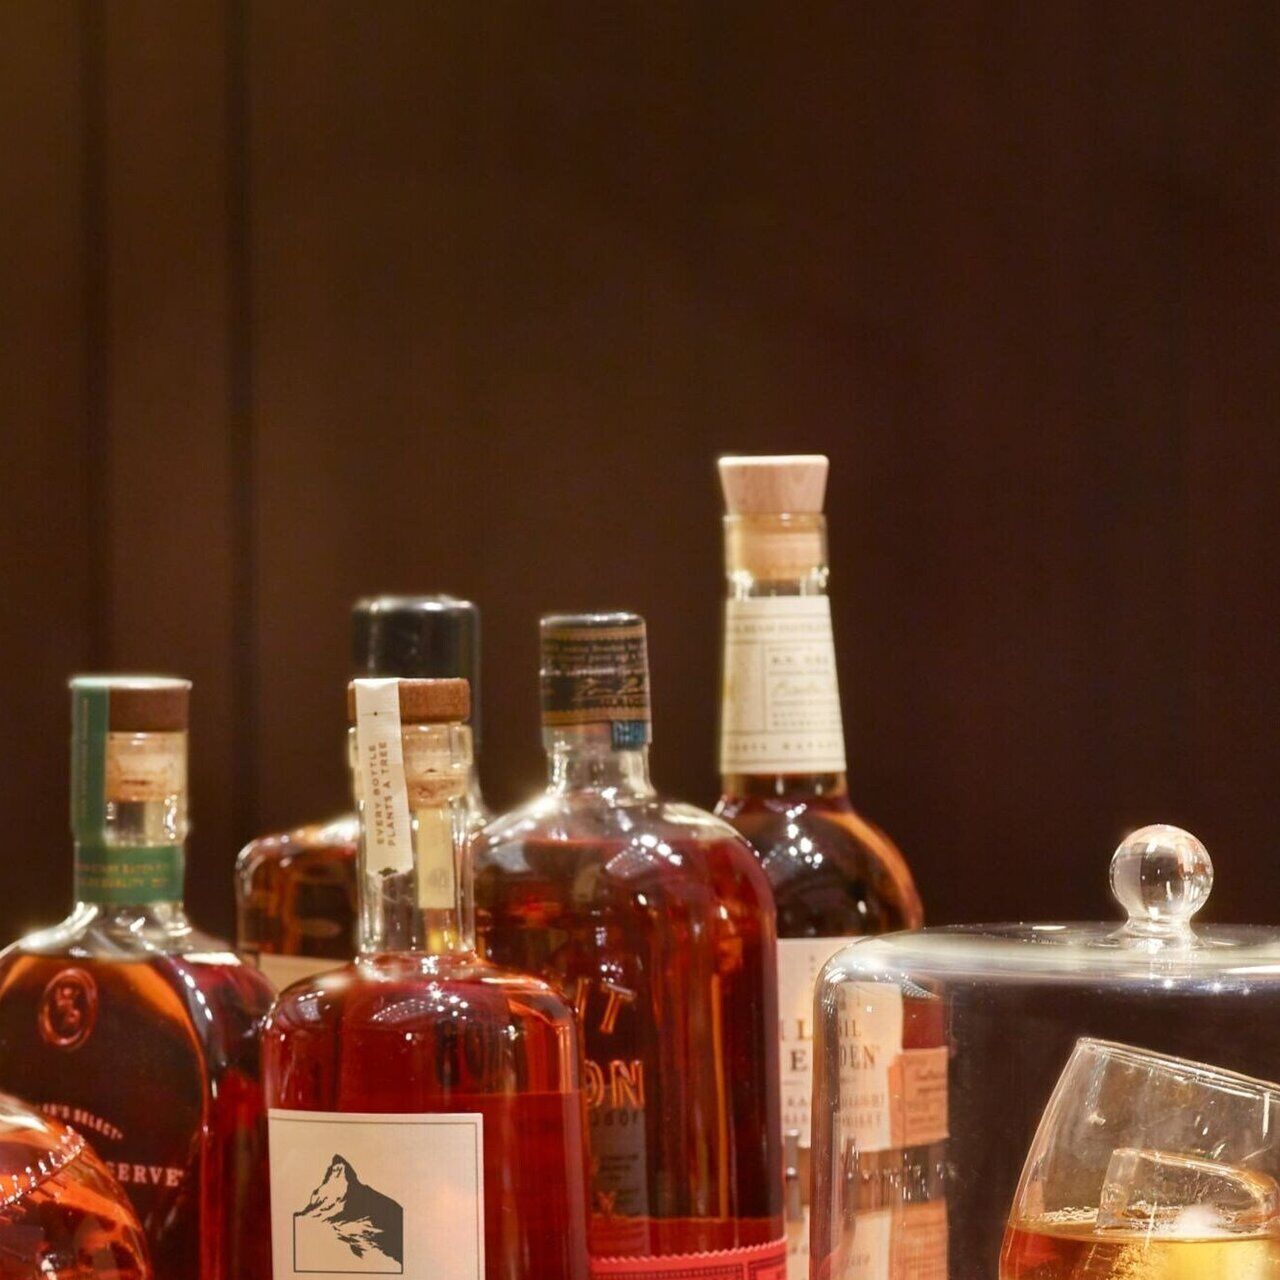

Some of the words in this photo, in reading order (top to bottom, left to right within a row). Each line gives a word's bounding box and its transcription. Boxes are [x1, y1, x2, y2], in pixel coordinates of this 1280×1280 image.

[369, 744, 380, 796] BOTTLE
[378, 741, 389, 775] TREE
[375, 802, 385, 845] EVERY
[384, 796, 397, 846] PLANTS
